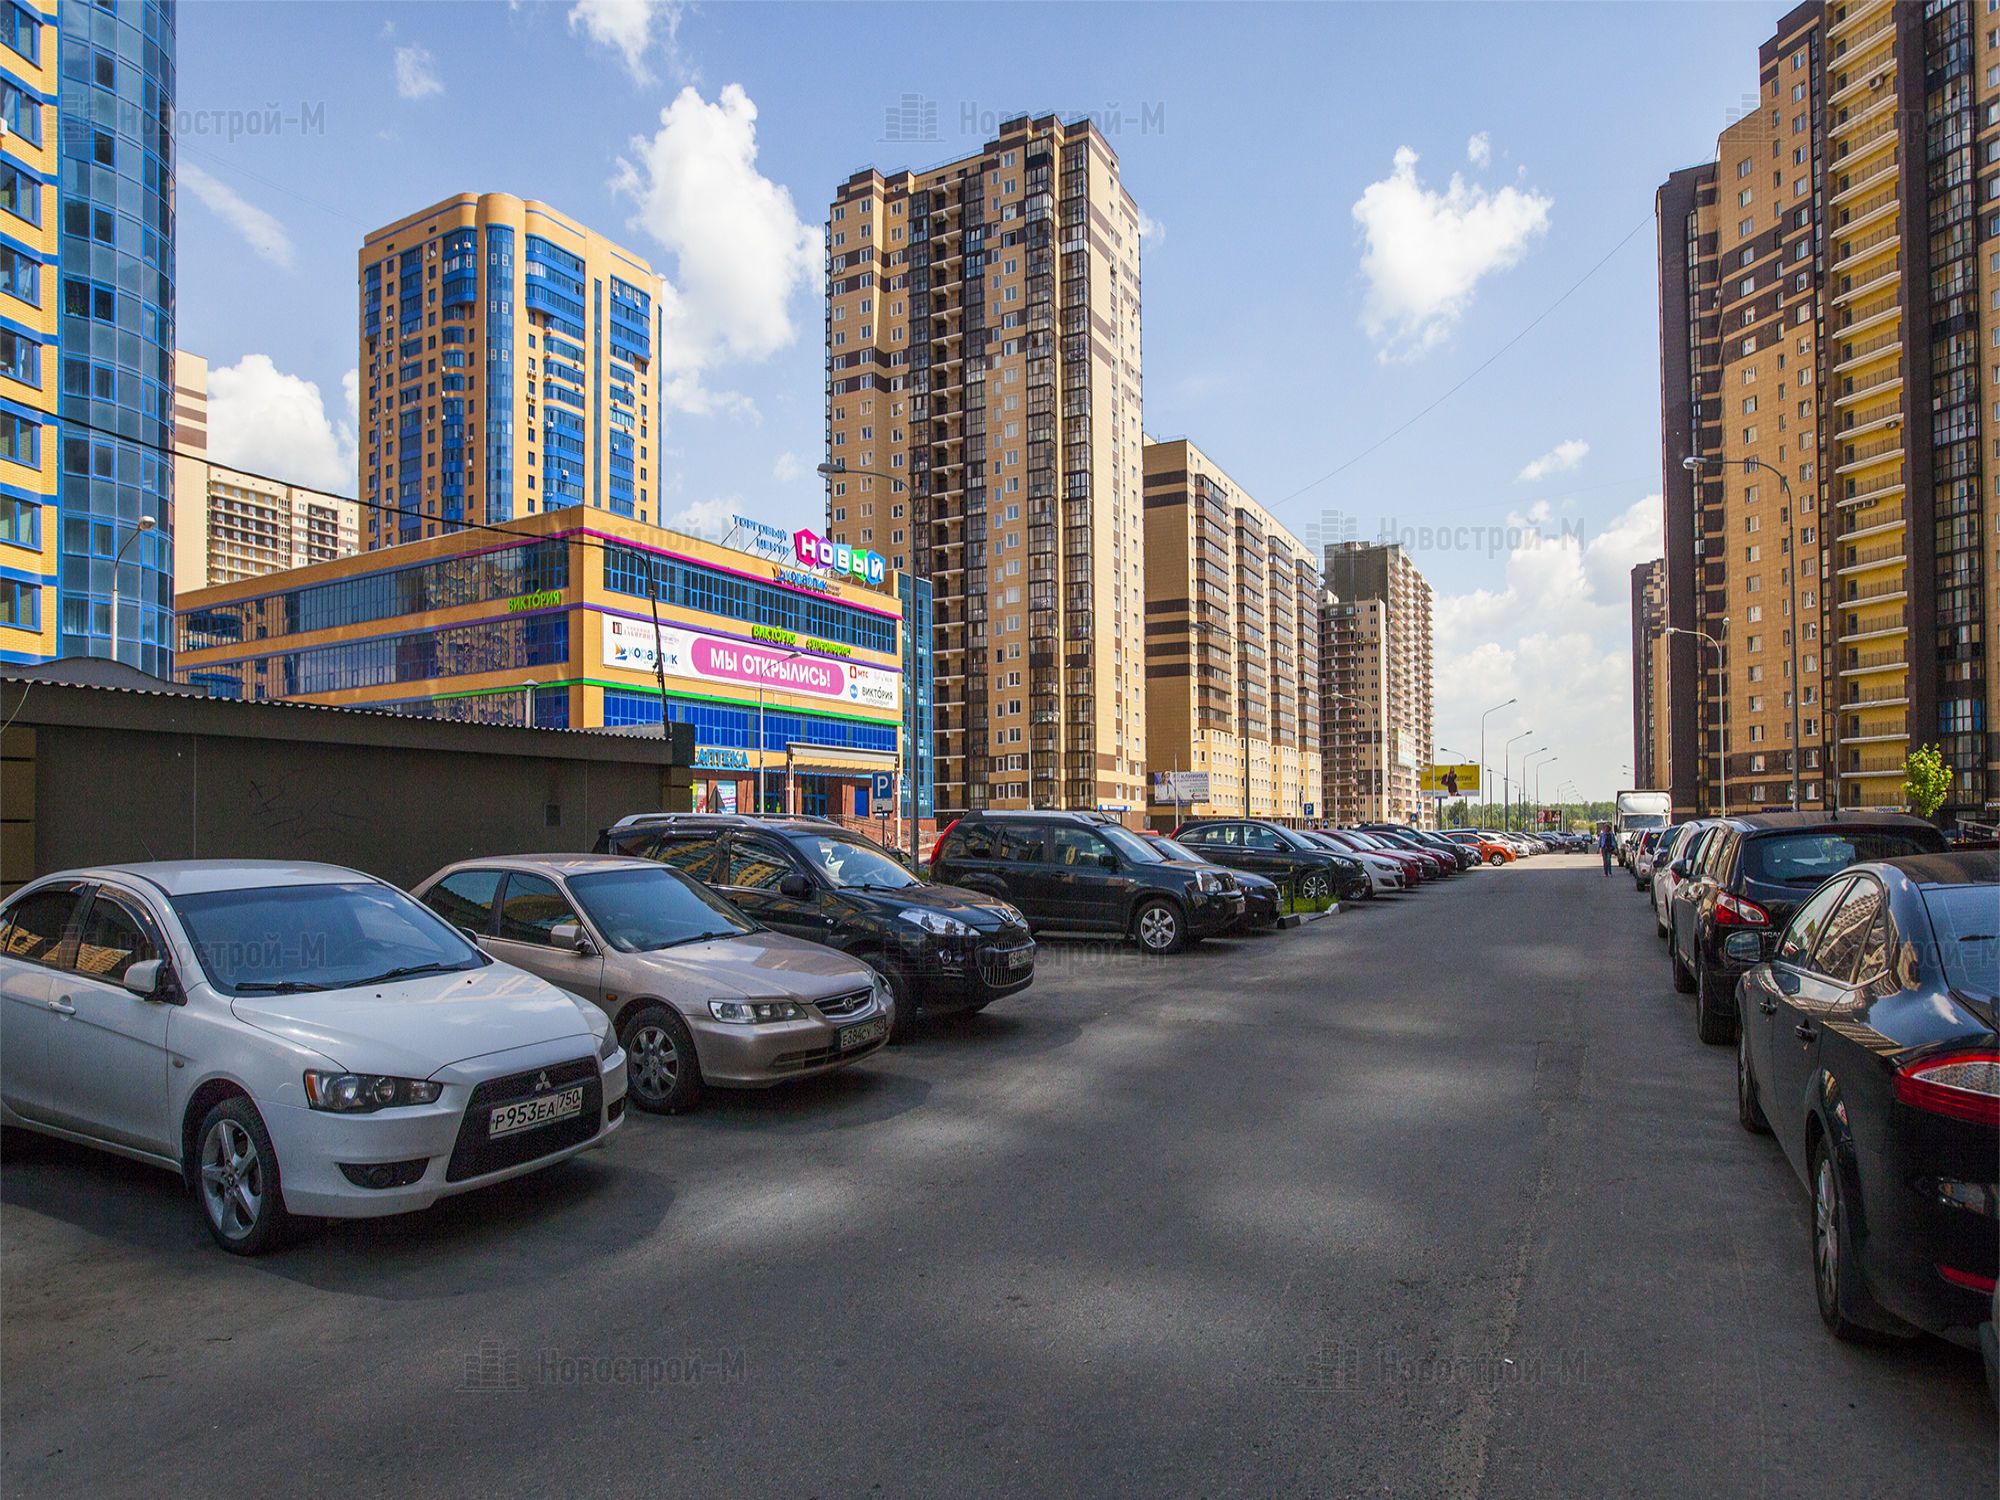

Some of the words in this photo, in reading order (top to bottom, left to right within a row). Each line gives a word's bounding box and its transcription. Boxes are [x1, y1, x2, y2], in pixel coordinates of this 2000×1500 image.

[801, 536, 885, 582] НОВЫЙ
[710, 647, 738, 671] МЫ
[742, 654, 831, 688] ОТКРЫЛИСЬ!
[698, 748, 749, 767] АПТЕКА
[494, 1101, 555, 1130] Р953ЕА
[559, 1090, 579, 1108] 750
